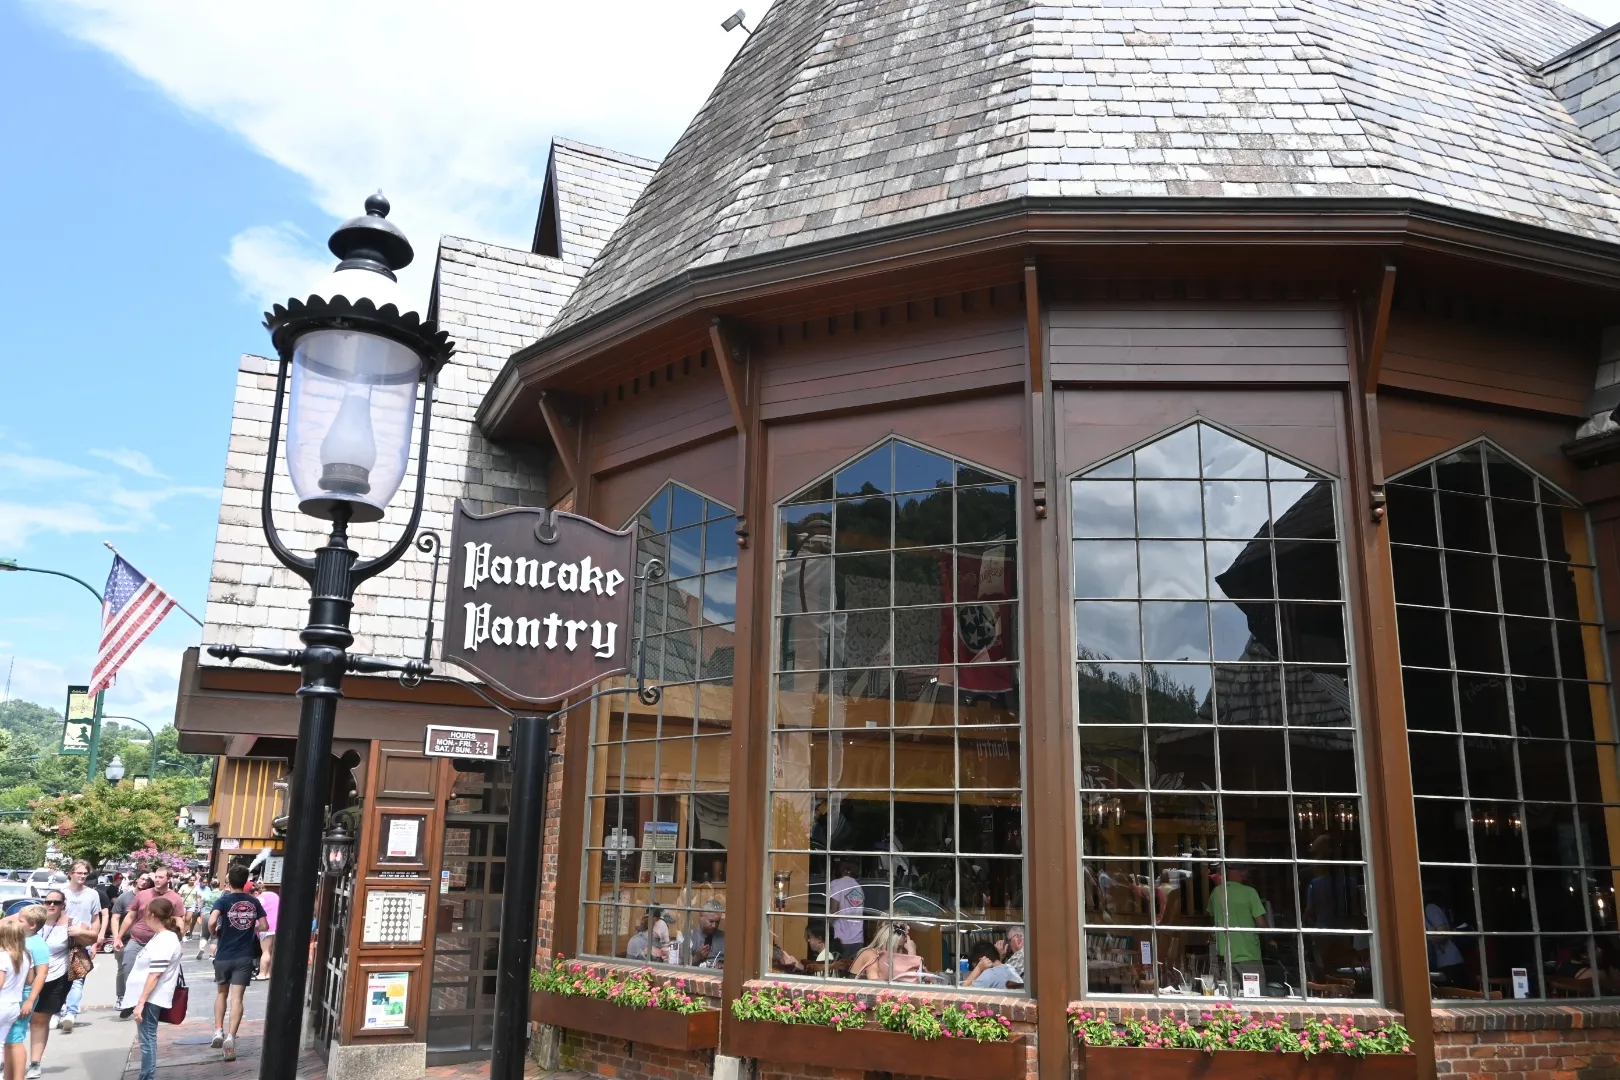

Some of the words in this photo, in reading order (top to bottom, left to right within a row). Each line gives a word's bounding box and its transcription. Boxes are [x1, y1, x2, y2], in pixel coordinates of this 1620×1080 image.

[463, 541, 626, 597] Pancake
[463, 602, 619, 659] Pantry
[450, 732, 476, 740] HOURS
